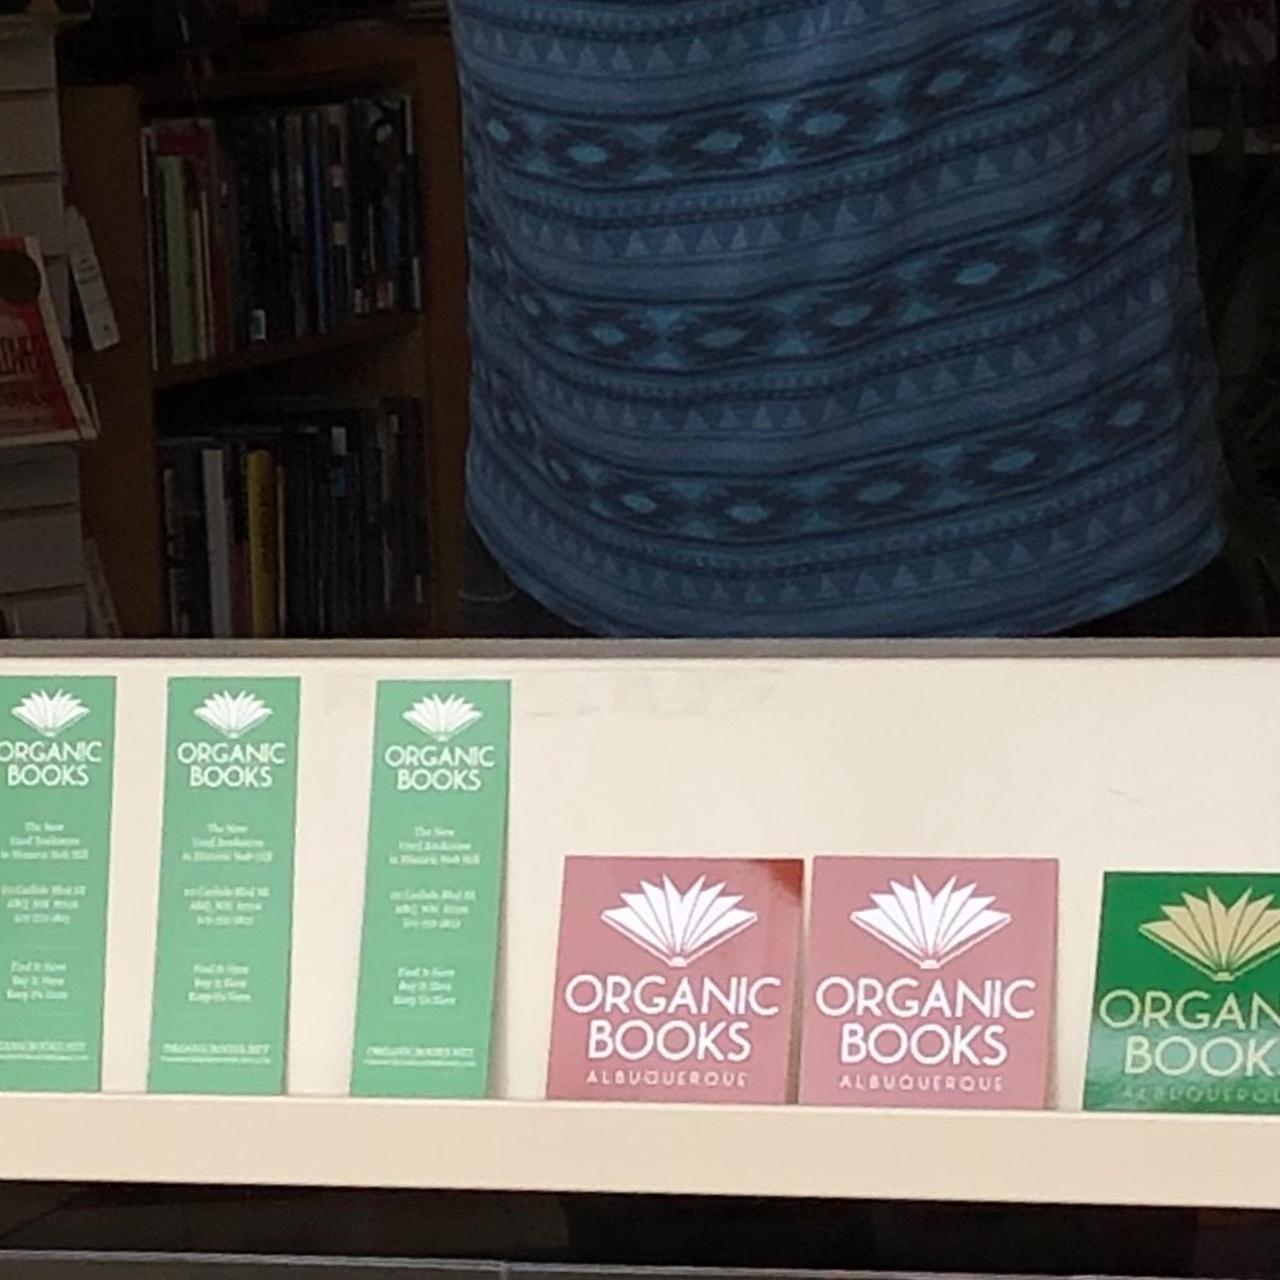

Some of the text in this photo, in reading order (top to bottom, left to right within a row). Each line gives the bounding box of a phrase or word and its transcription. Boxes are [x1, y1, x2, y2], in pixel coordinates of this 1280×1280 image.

[176, 741, 287, 766] ORGANIC
[384, 744, 496, 770] ORGANIC
[6, 764, 90, 788] BOOKS
[188, 765, 273, 789] BOOKS
[395, 767, 482, 793] BOOKS
[564, 974, 782, 1017] ORGANIC
[814, 977, 1037, 1020] ORGANIC
[587, 1019, 752, 1064] BOOKS
[840, 1023, 1008, 1068] BOOKS
[585, 1069, 750, 1089] ALBUQUERQUE
[838, 1074, 1004, 1094] ALBUQUERQUE
